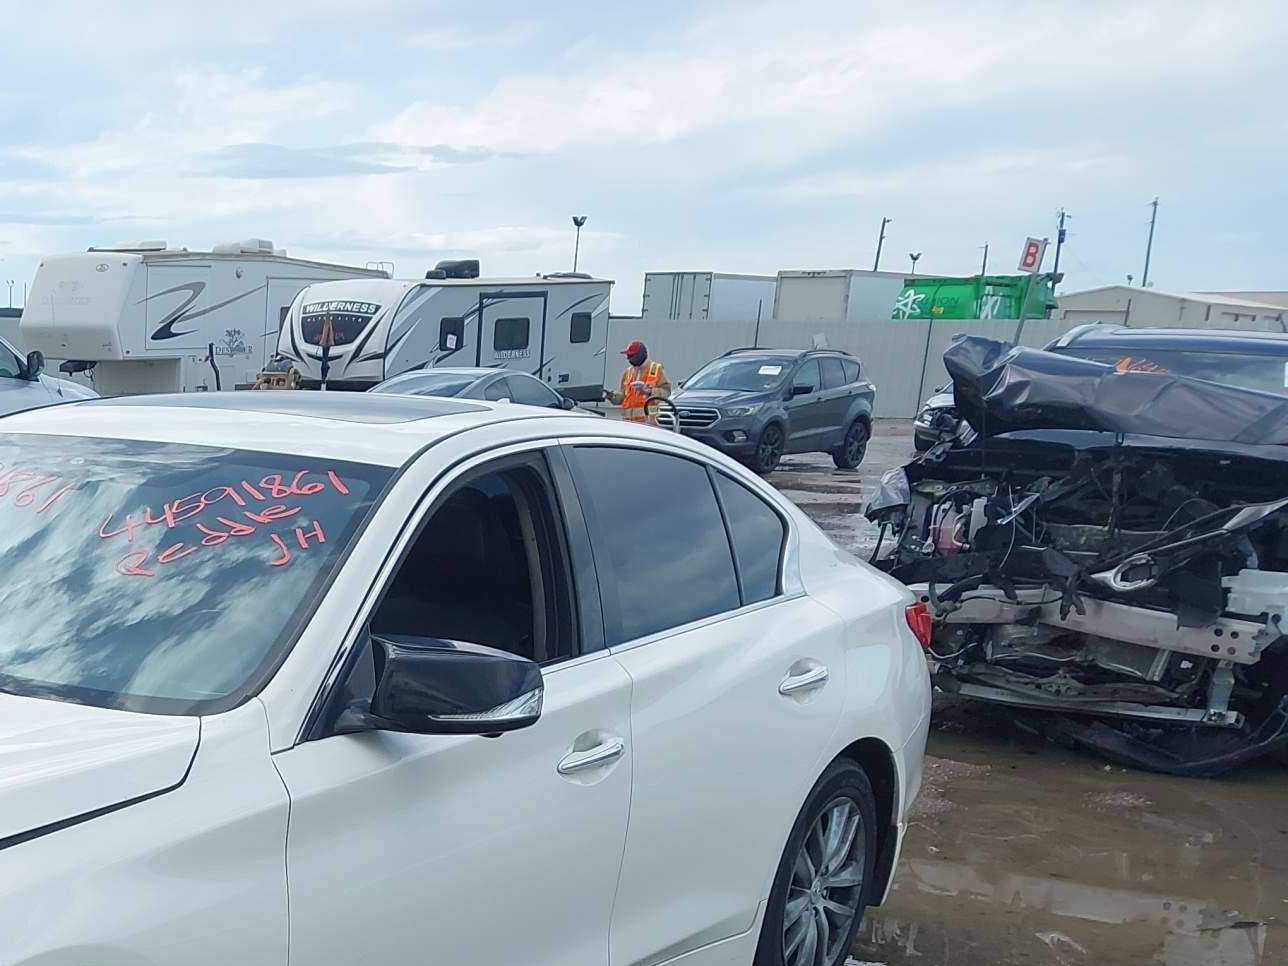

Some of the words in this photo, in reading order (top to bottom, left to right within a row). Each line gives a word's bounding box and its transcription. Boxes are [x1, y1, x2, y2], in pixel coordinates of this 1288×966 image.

[1022, 242, 1039, 267] B
[306, 302, 377, 313] WILDERNESS
[99, 470, 350, 542] 44591861
